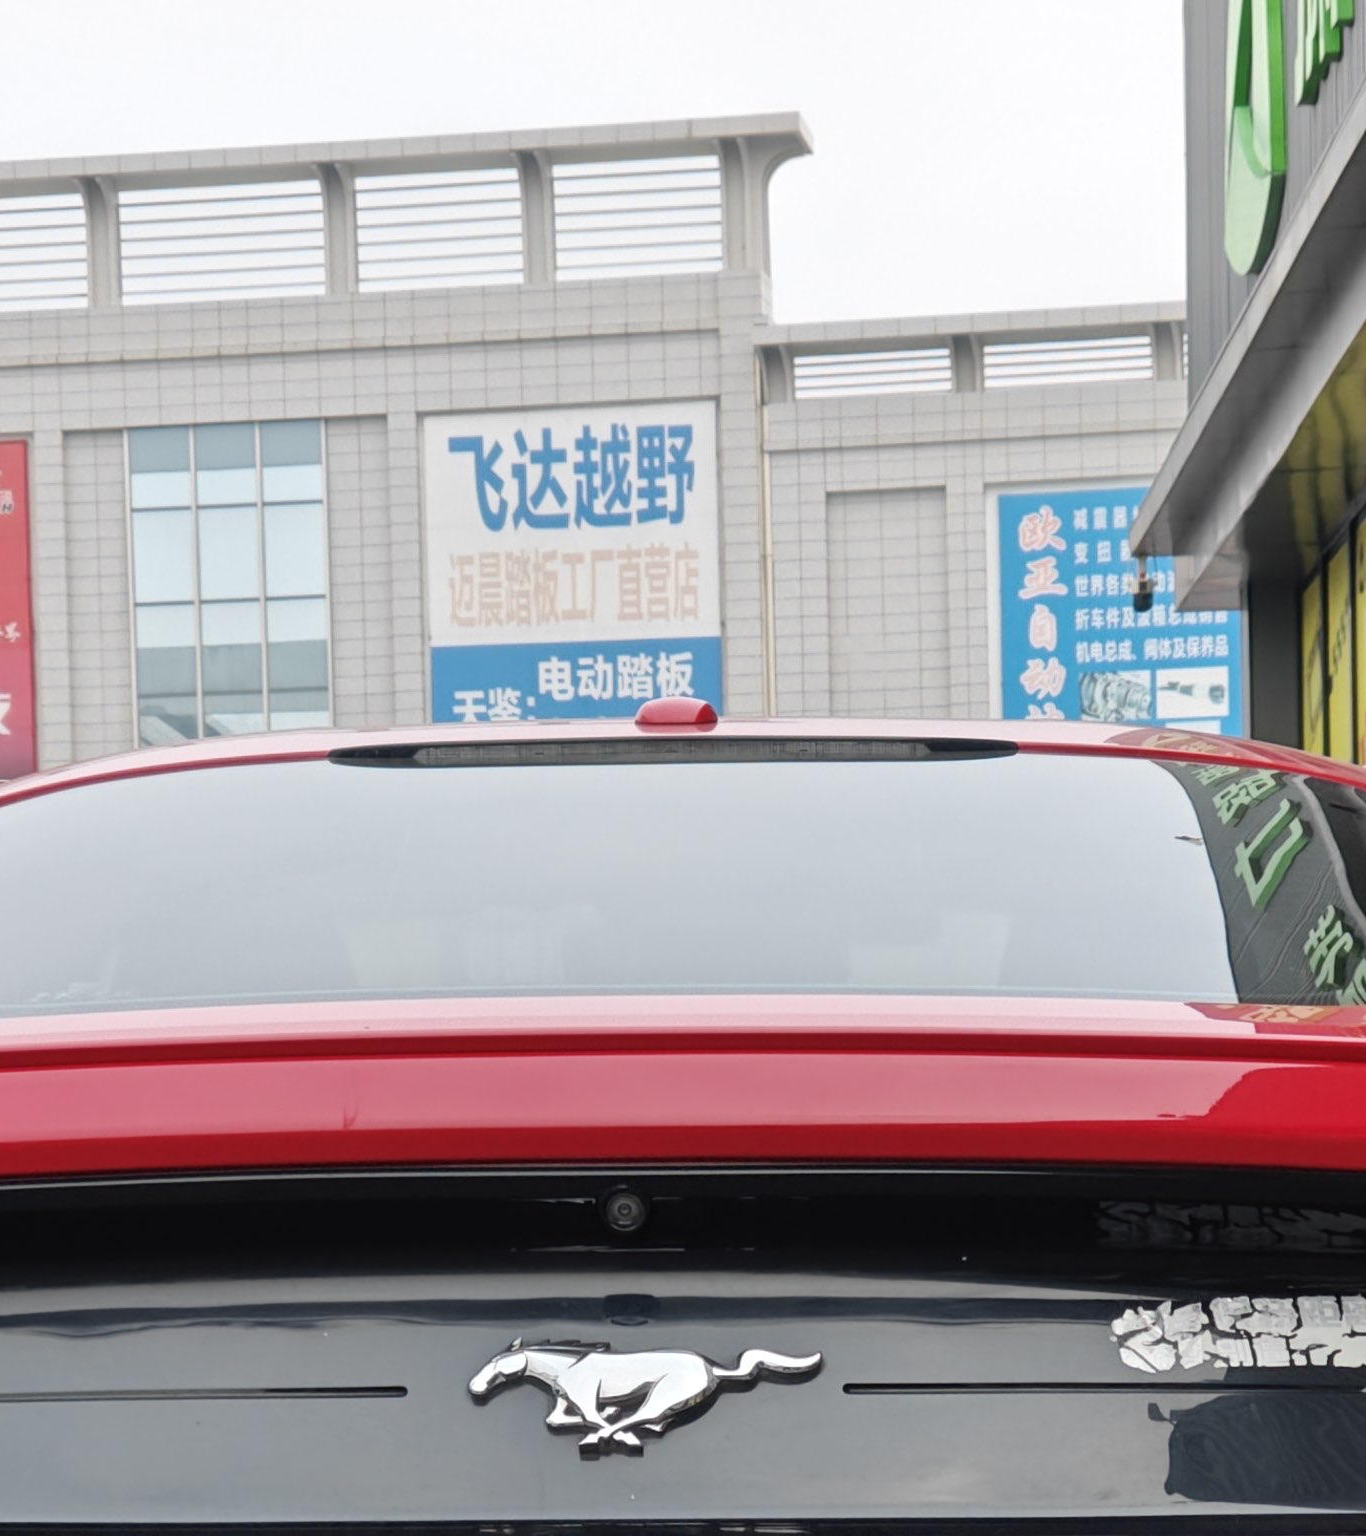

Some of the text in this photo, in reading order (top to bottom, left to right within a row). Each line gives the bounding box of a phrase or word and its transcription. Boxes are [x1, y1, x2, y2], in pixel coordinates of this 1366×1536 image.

[448, 423, 695, 532] 飞达越野
[537, 651, 695, 701] 电动踏板
